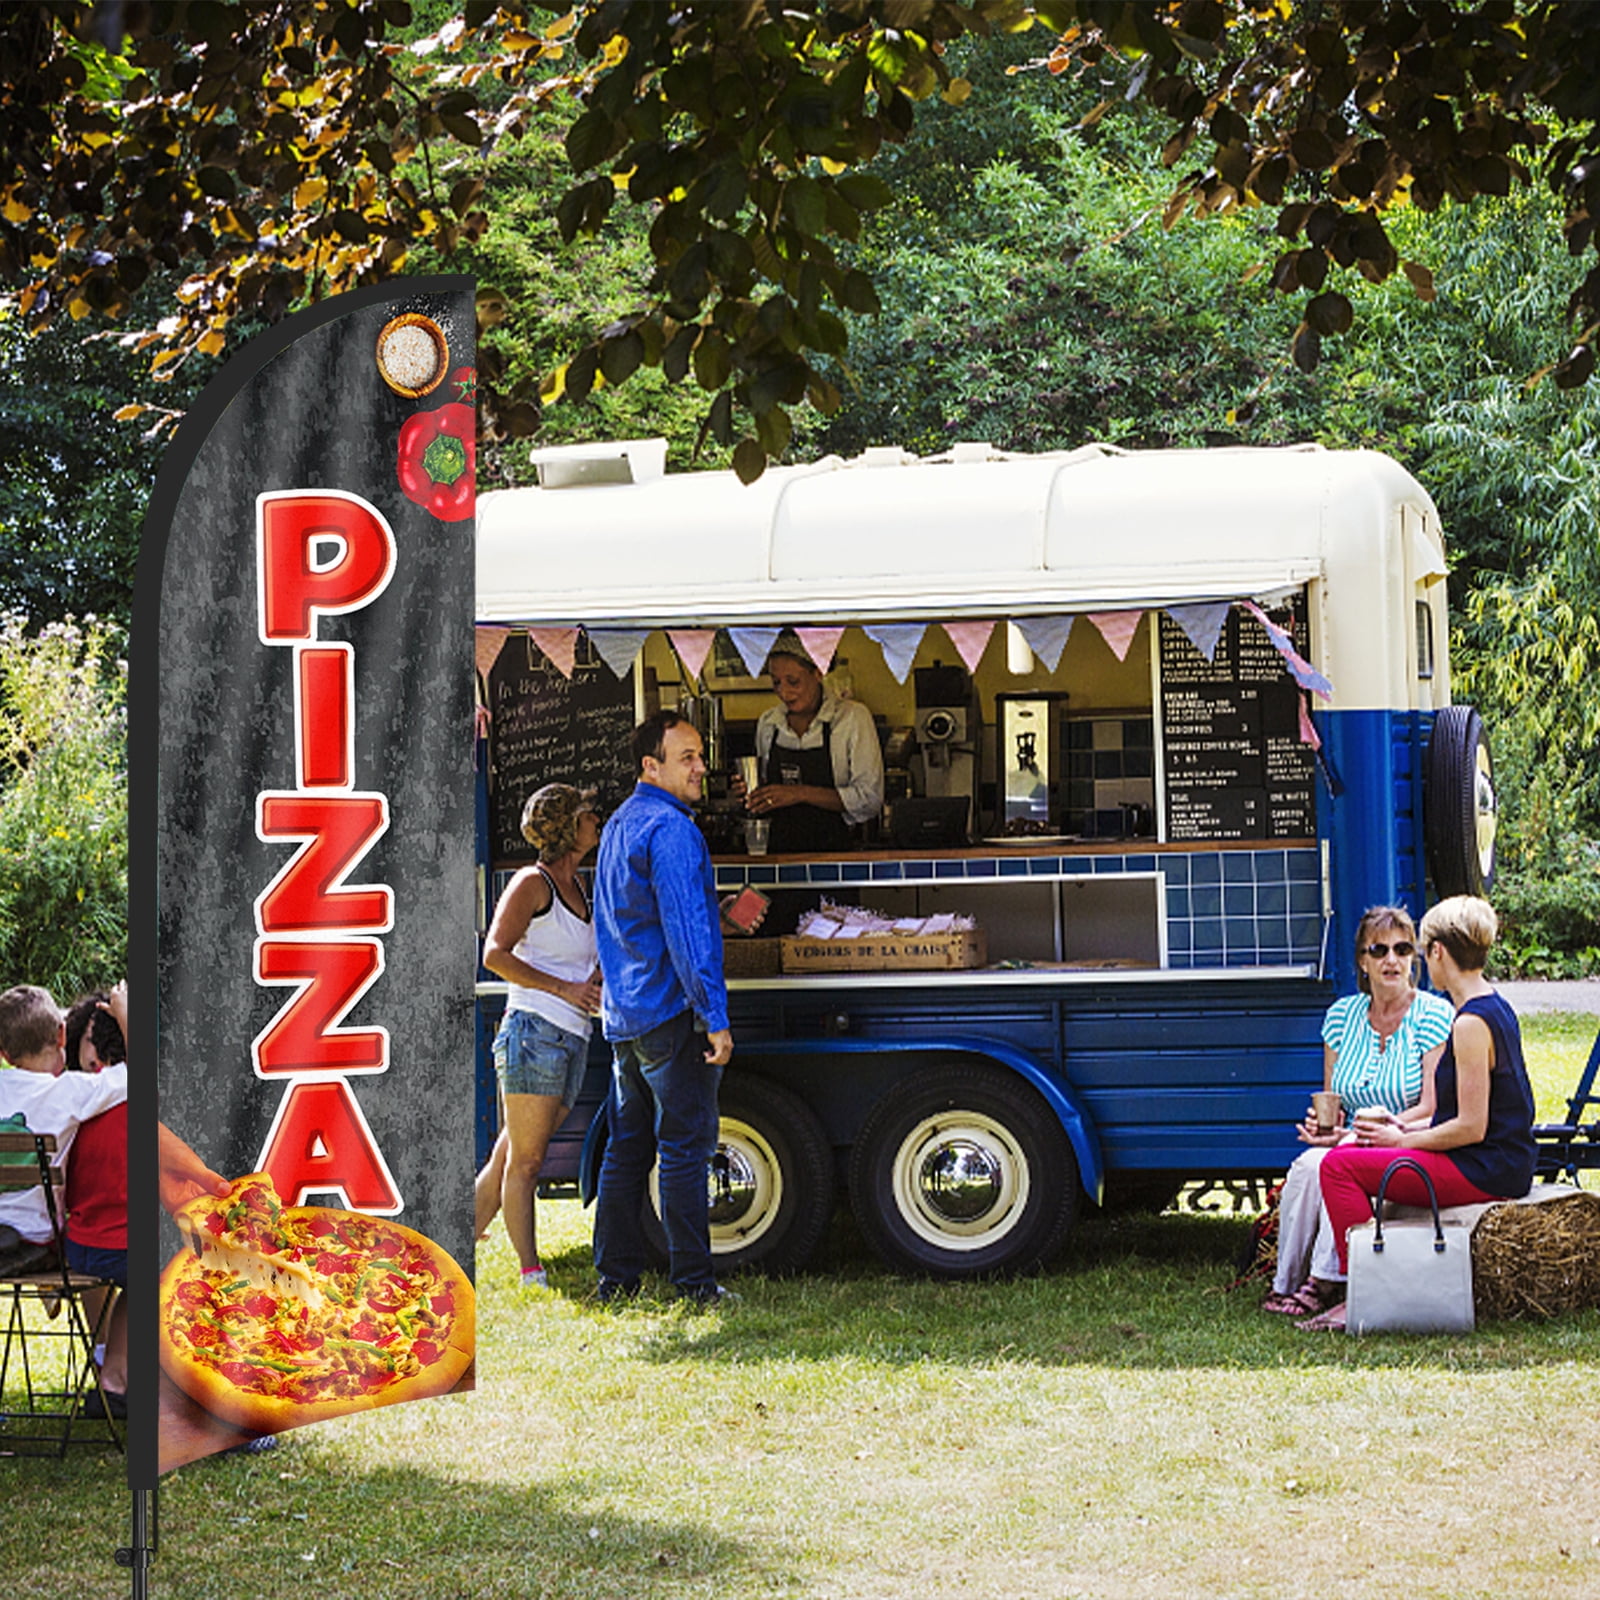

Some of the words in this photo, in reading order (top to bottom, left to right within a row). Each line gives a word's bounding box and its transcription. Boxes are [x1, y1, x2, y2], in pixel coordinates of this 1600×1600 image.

[254, 489, 402, 1214] PIZZA
[857, 946, 875, 956] DE
[881, 946, 898, 956] LA
